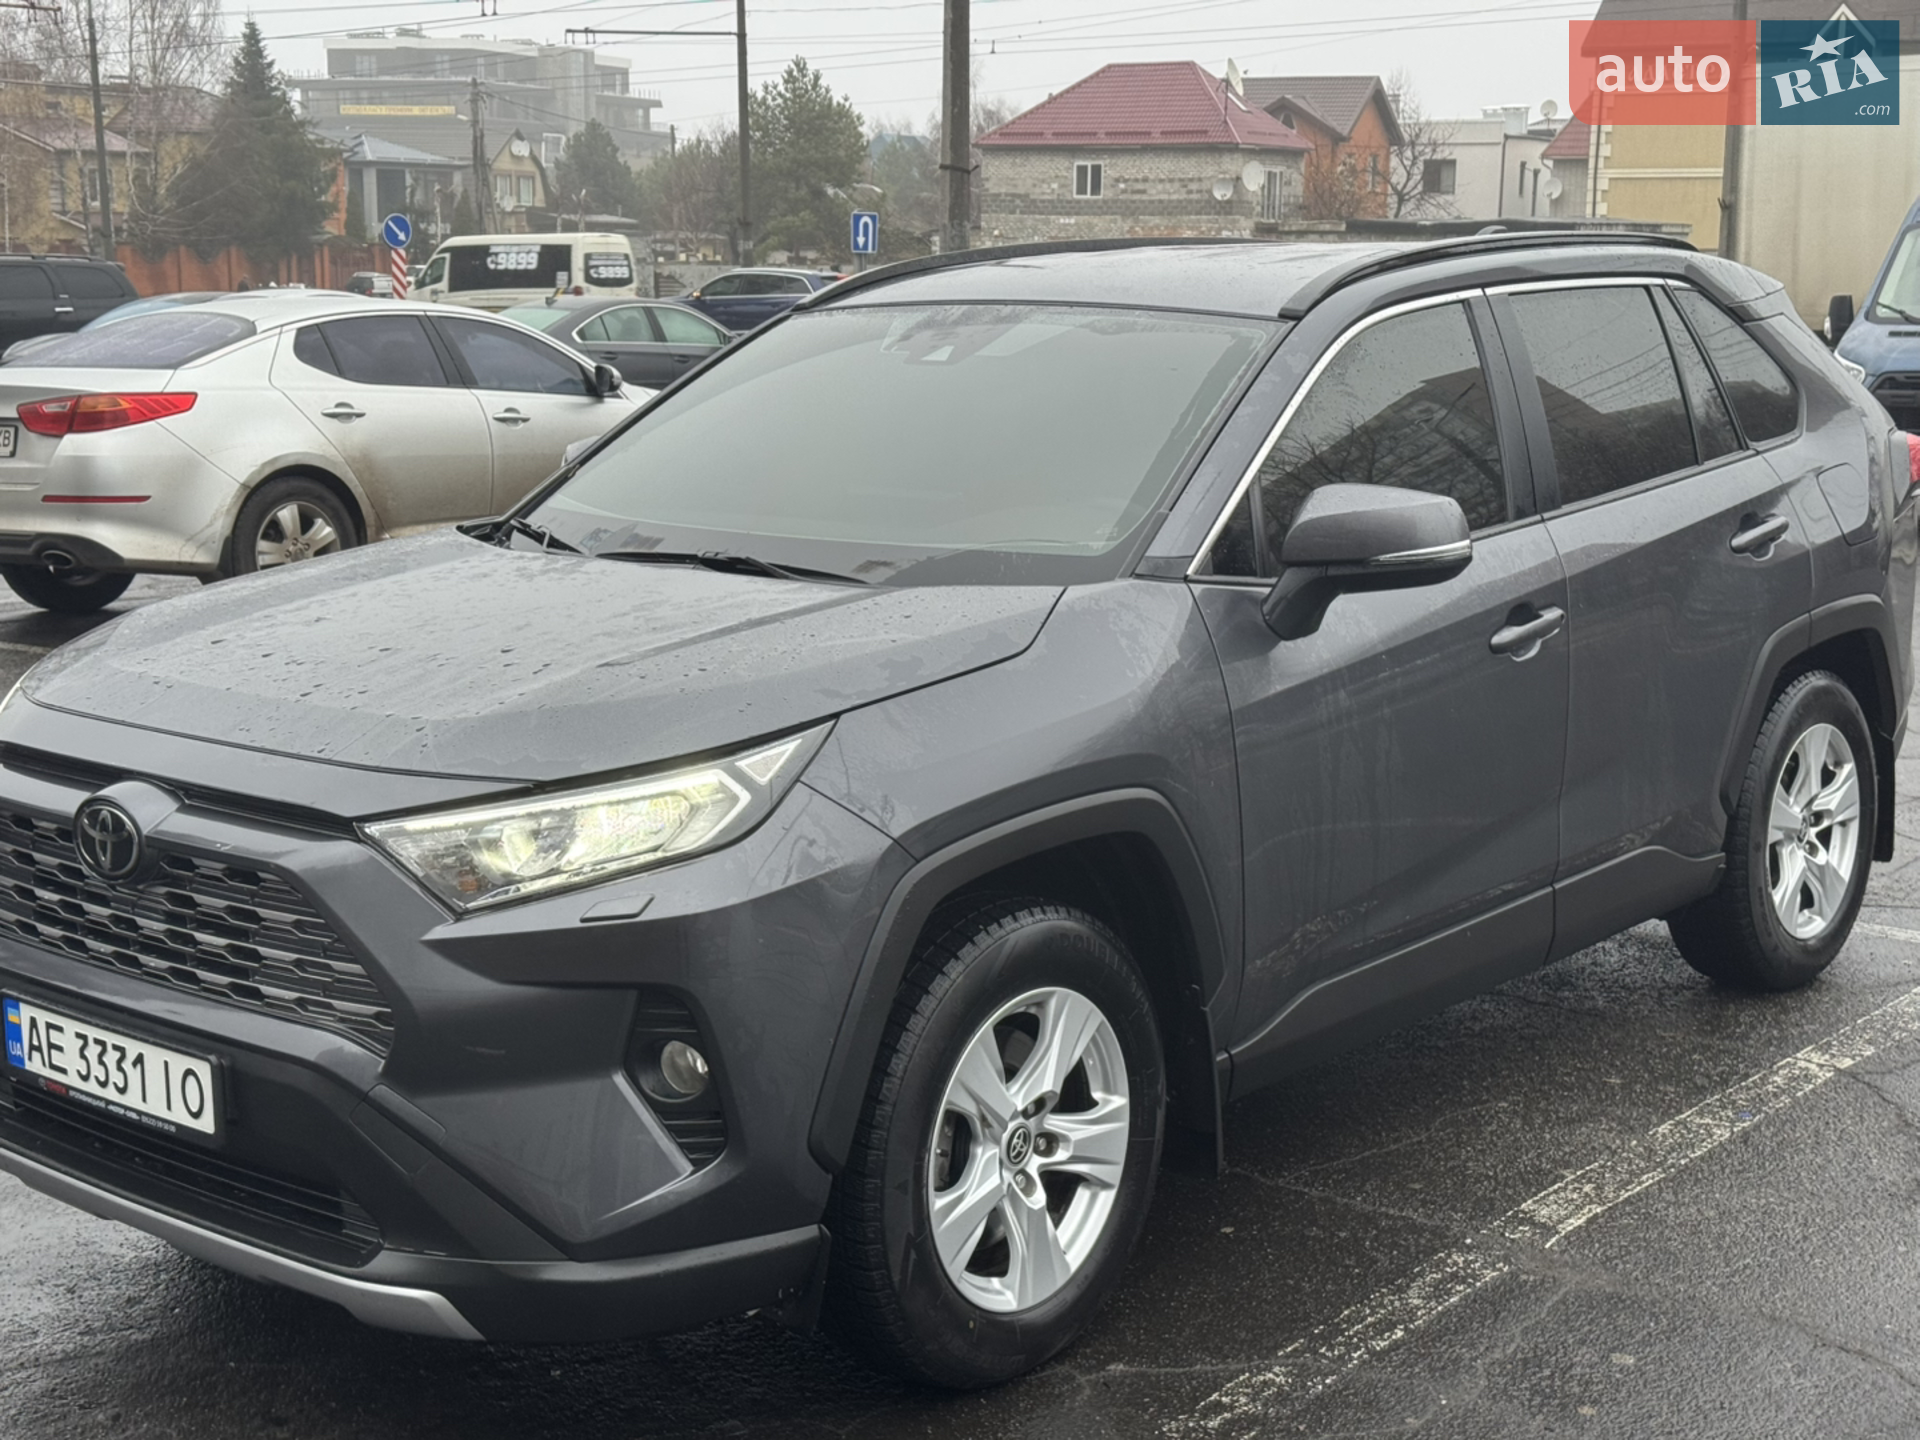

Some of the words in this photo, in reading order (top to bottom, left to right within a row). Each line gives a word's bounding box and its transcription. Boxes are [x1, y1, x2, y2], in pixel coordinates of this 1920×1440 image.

[496, 252, 539, 270] 9899
[9, 1039, 24, 1058] UA
[27, 1015, 68, 1077] AE
[75, 1031, 148, 1104] 3331
[163, 1059, 205, 1120] IO
